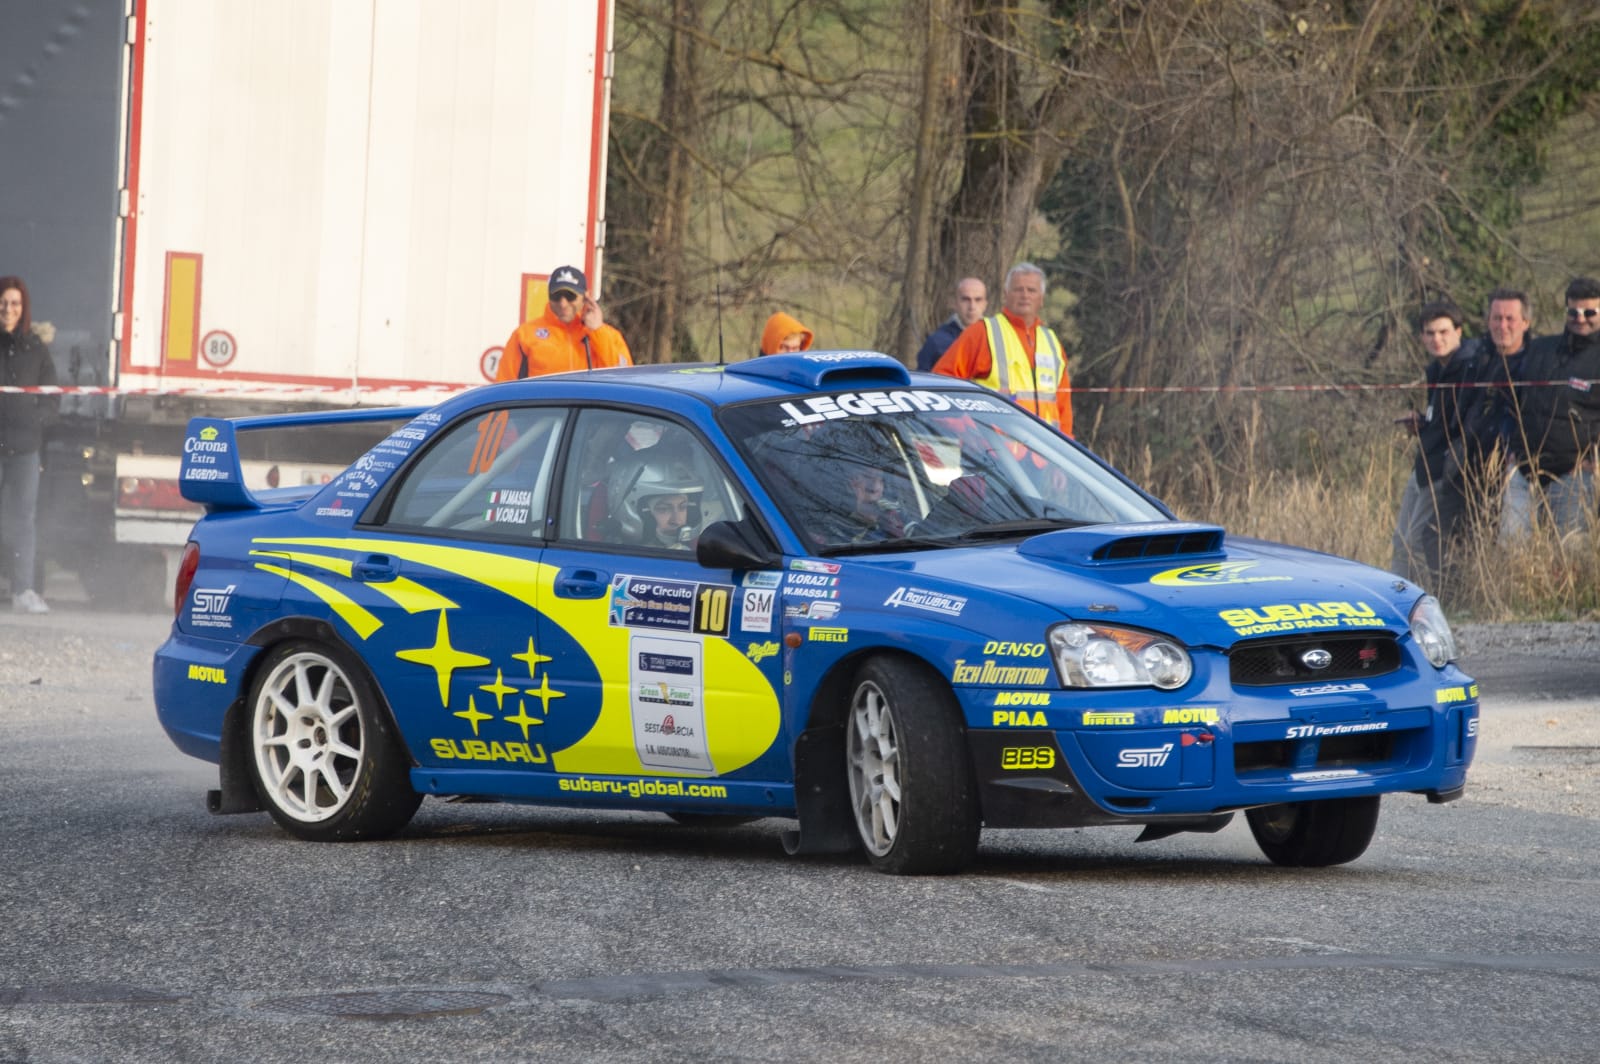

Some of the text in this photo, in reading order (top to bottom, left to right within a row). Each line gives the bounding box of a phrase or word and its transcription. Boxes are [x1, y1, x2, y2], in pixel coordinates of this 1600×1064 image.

[210, 339, 229, 356] 80
[779, 391, 951, 425] LEGEND
[184, 436, 228, 453] Corona
[467, 409, 509, 475] 10
[191, 452, 216, 464] Extra
[185, 468, 217, 480] LEGEND
[499, 489, 532, 506] W.MASSA
[495, 507, 529, 524] V.ORAZI
[787, 573, 829, 586] V.ORAZI
[652, 585, 692, 599] Circuito
[783, 586, 828, 599] W.MASSA
[699, 588, 728, 632] 10
[745, 592, 772, 614] SM
[1218, 601, 1376, 627] SUBARU
[809, 626, 849, 643] PIRELLI
[1234, 616, 1386, 637] WORLD RALLY TEAM
[983, 641, 1046, 658] DENSO
[188, 664, 227, 684] MOTUL
[952, 659, 1050, 686] TECH NUTRITION
[993, 691, 1051, 706] MOTUL
[992, 710, 1049, 727] PIAA
[1082, 711, 1136, 726] PIRELLI
[1162, 708, 1220, 724] MOTUL
[1285, 721, 1389, 739] STI Performance
[429, 737, 548, 764] SUBARU
[1001, 747, 1056, 769] BBS
[558, 776, 728, 799] subaru-global.com
